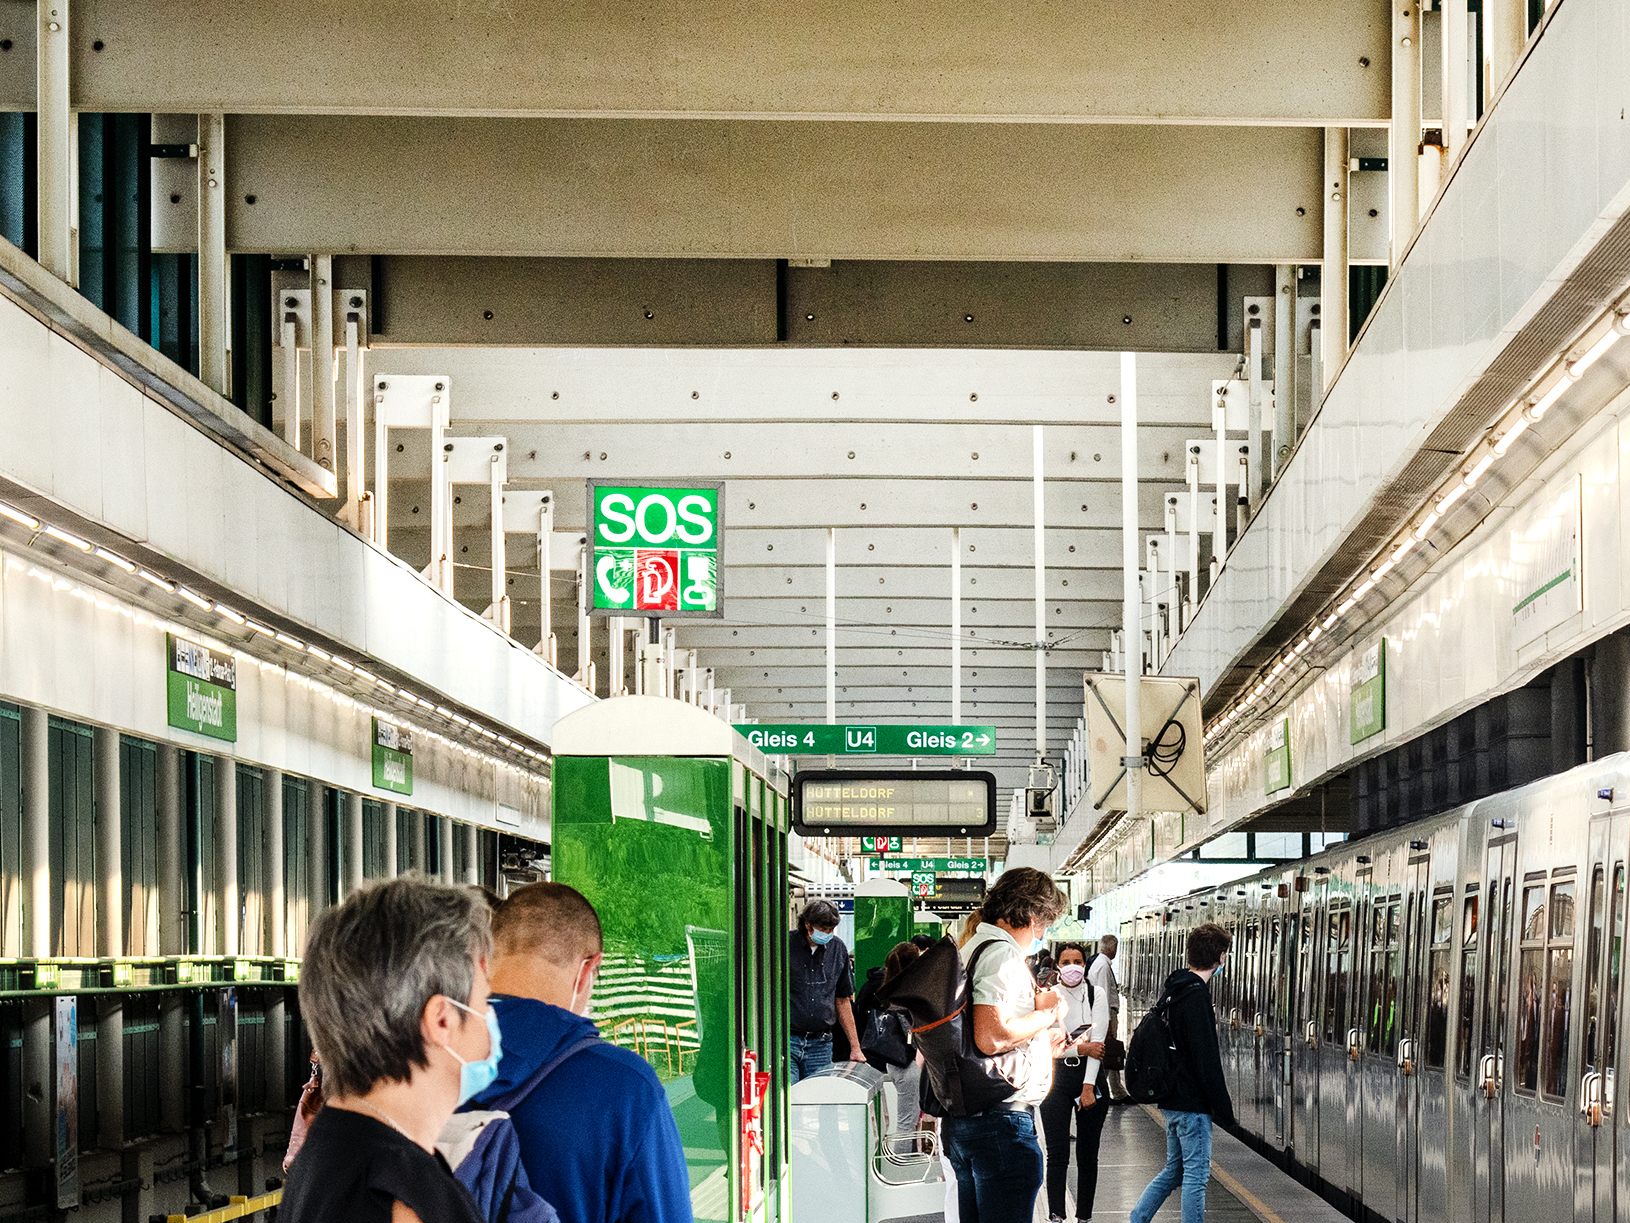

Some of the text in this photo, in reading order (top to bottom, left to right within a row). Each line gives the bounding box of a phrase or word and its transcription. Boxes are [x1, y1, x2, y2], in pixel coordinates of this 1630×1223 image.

[598, 493, 714, 544] SOS
[748, 730, 974, 749] Gleis 4 U4 Gleis 2
[806, 786, 895, 799] HÜTTELDORF
[806, 806, 895, 819] HÜTTELDORF
[881, 861, 902, 869] leis
[921, 861, 934, 869] U4
[947, 861, 969, 869] Gleis
[912, 873, 935, 884] SOS
